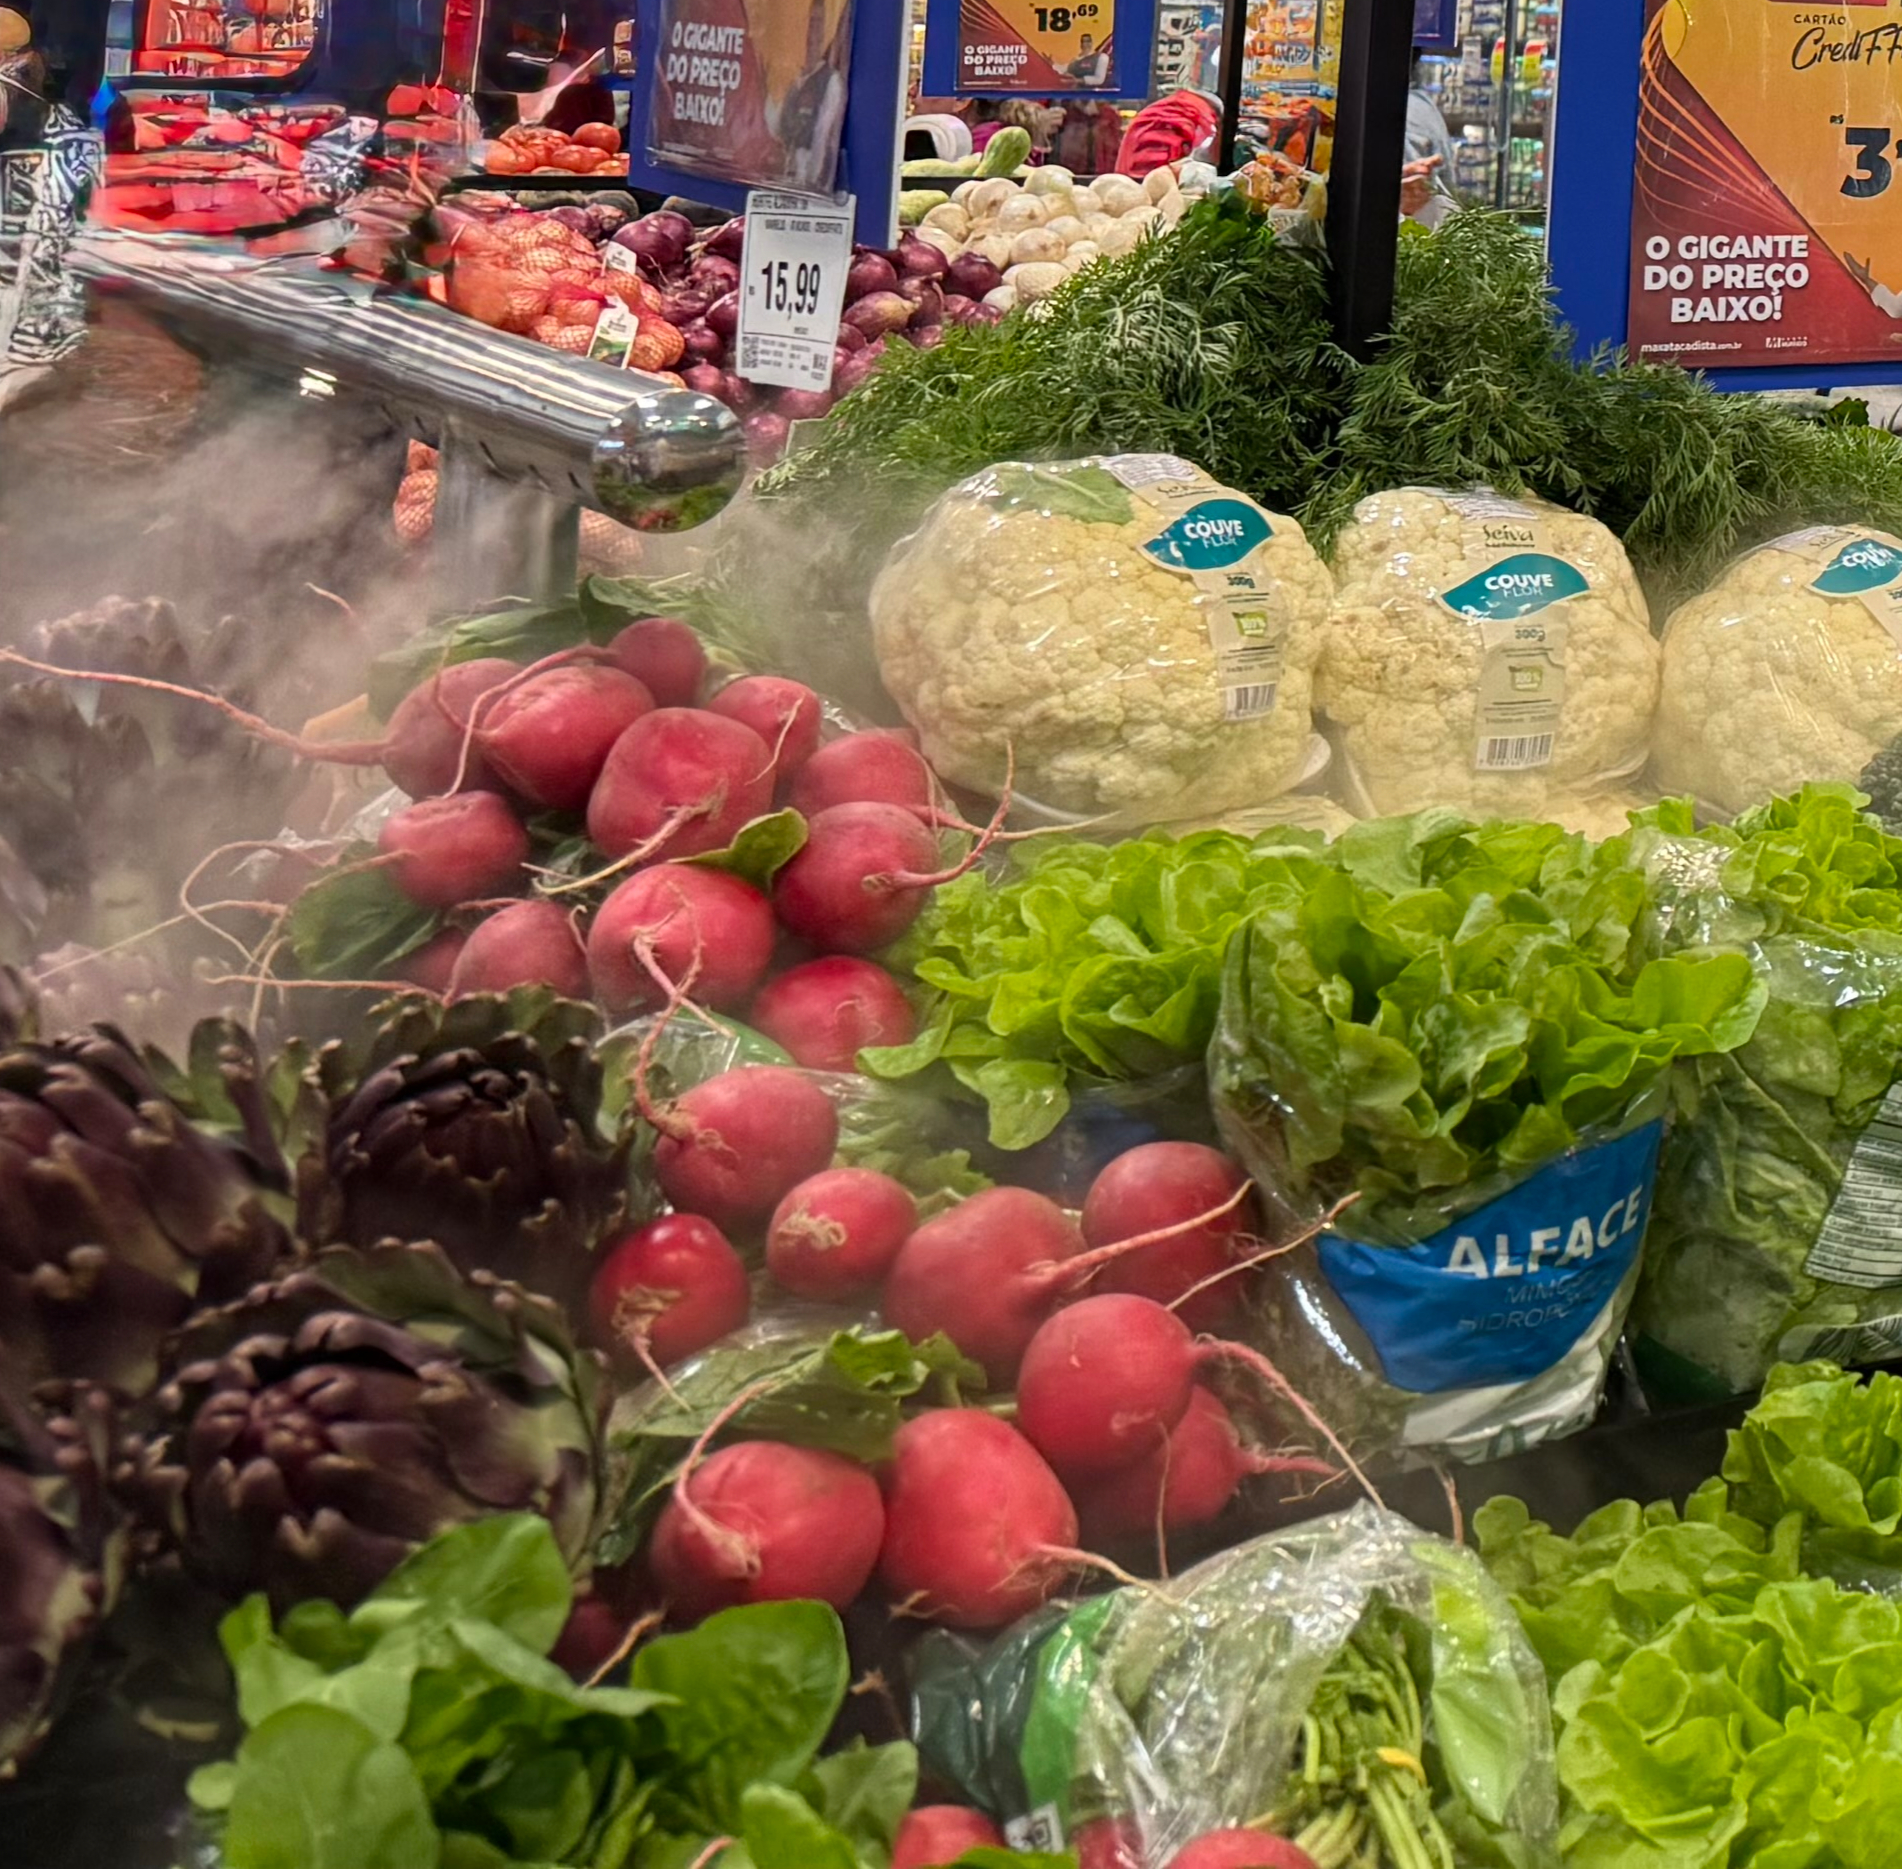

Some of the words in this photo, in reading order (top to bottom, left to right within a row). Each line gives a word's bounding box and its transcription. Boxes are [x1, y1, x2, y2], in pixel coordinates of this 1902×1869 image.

[1034, 4, 1099, 32] 18,69
[1793, 13, 1847, 26] CARTÃO
[685, 25, 744, 55] GIGANTE
[977, 45, 1027, 55] GIGANTE
[975, 65, 1017, 76] BAIXO!
[986, 55, 1027, 68] PREÇO
[667, 57, 686, 83] DO
[689, 58, 740, 97] PREÇO
[673, 90, 726, 127] BAIXO!
[1677, 235, 1809, 260] GIGANTE
[761, 260, 821, 320] 15,99
[1644, 264, 1694, 291] DO
[1702, 263, 1809, 298] PREÇO
[1671, 295, 1783, 323] BAIXO!
[1184, 519, 1244, 539] COUVE
[1485, 574, 1554, 591] COUVE
[1441, 1184, 1643, 1280] ALFACE
